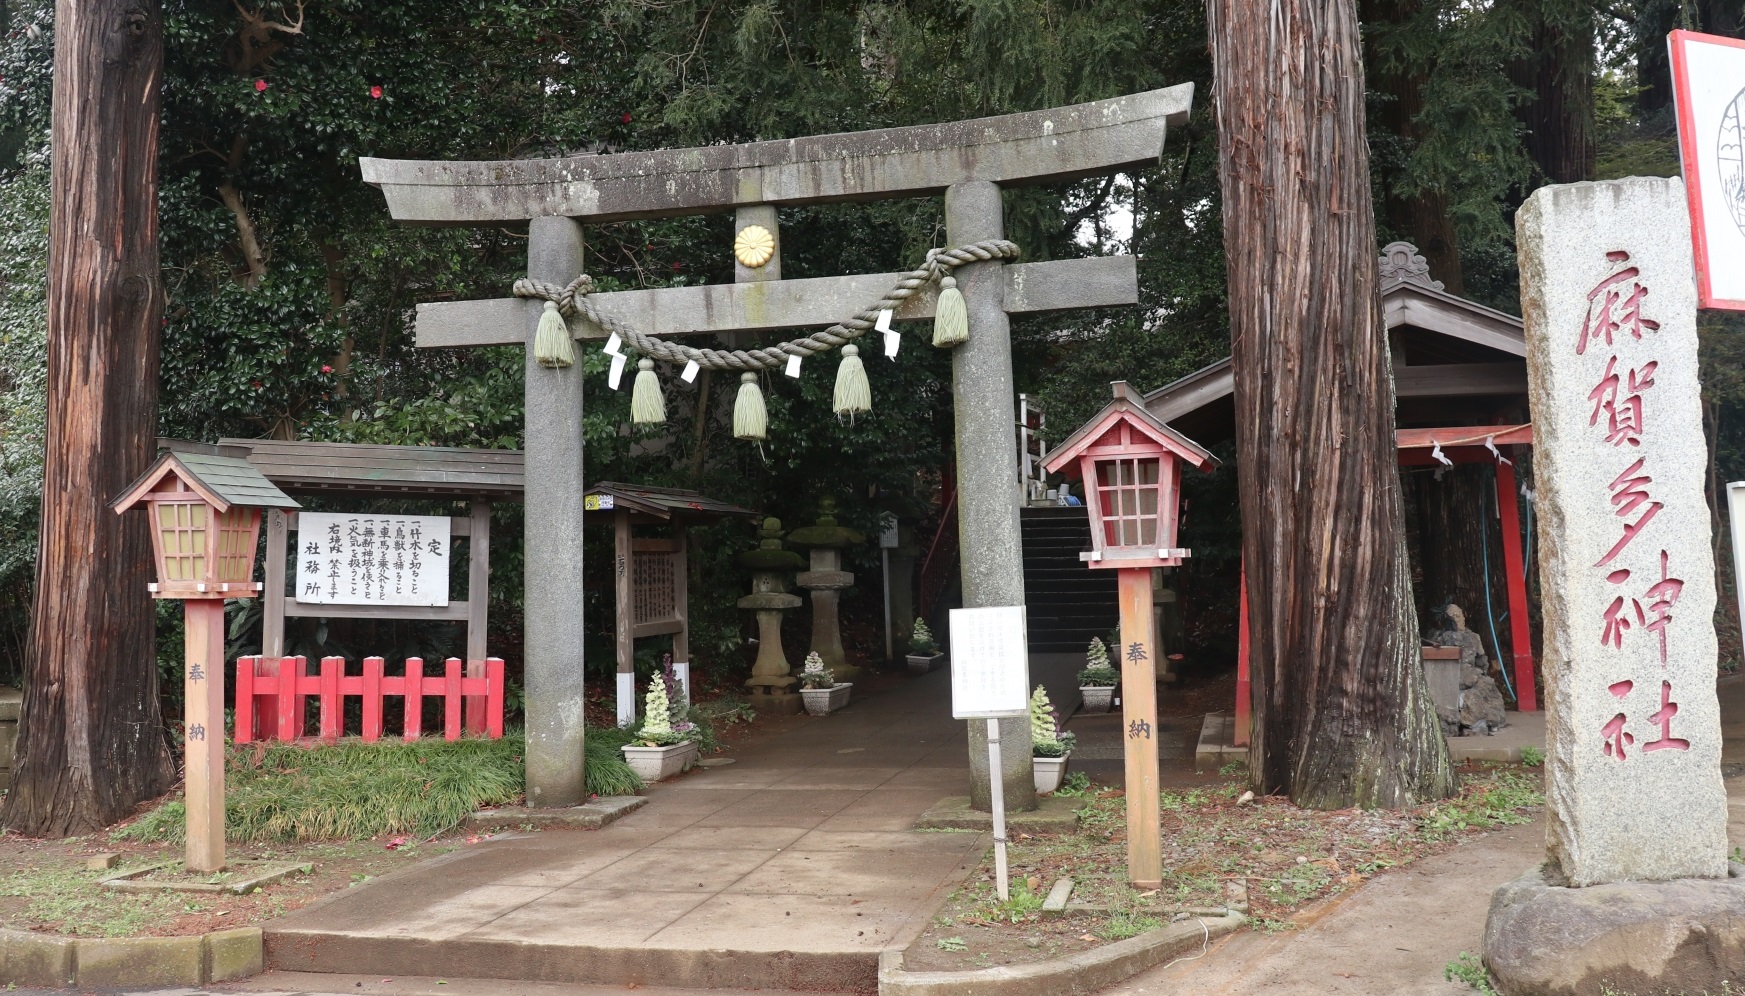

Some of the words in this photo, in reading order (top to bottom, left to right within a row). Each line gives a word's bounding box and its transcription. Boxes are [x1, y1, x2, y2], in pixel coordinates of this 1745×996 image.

[1577, 250, 1690, 761] 麻賀多神社
[304, 541, 321, 597] 社務所
[427, 538, 443, 556] 定
[188, 662, 206, 742] 奉納
[1126, 642, 1151, 740] 奉納
